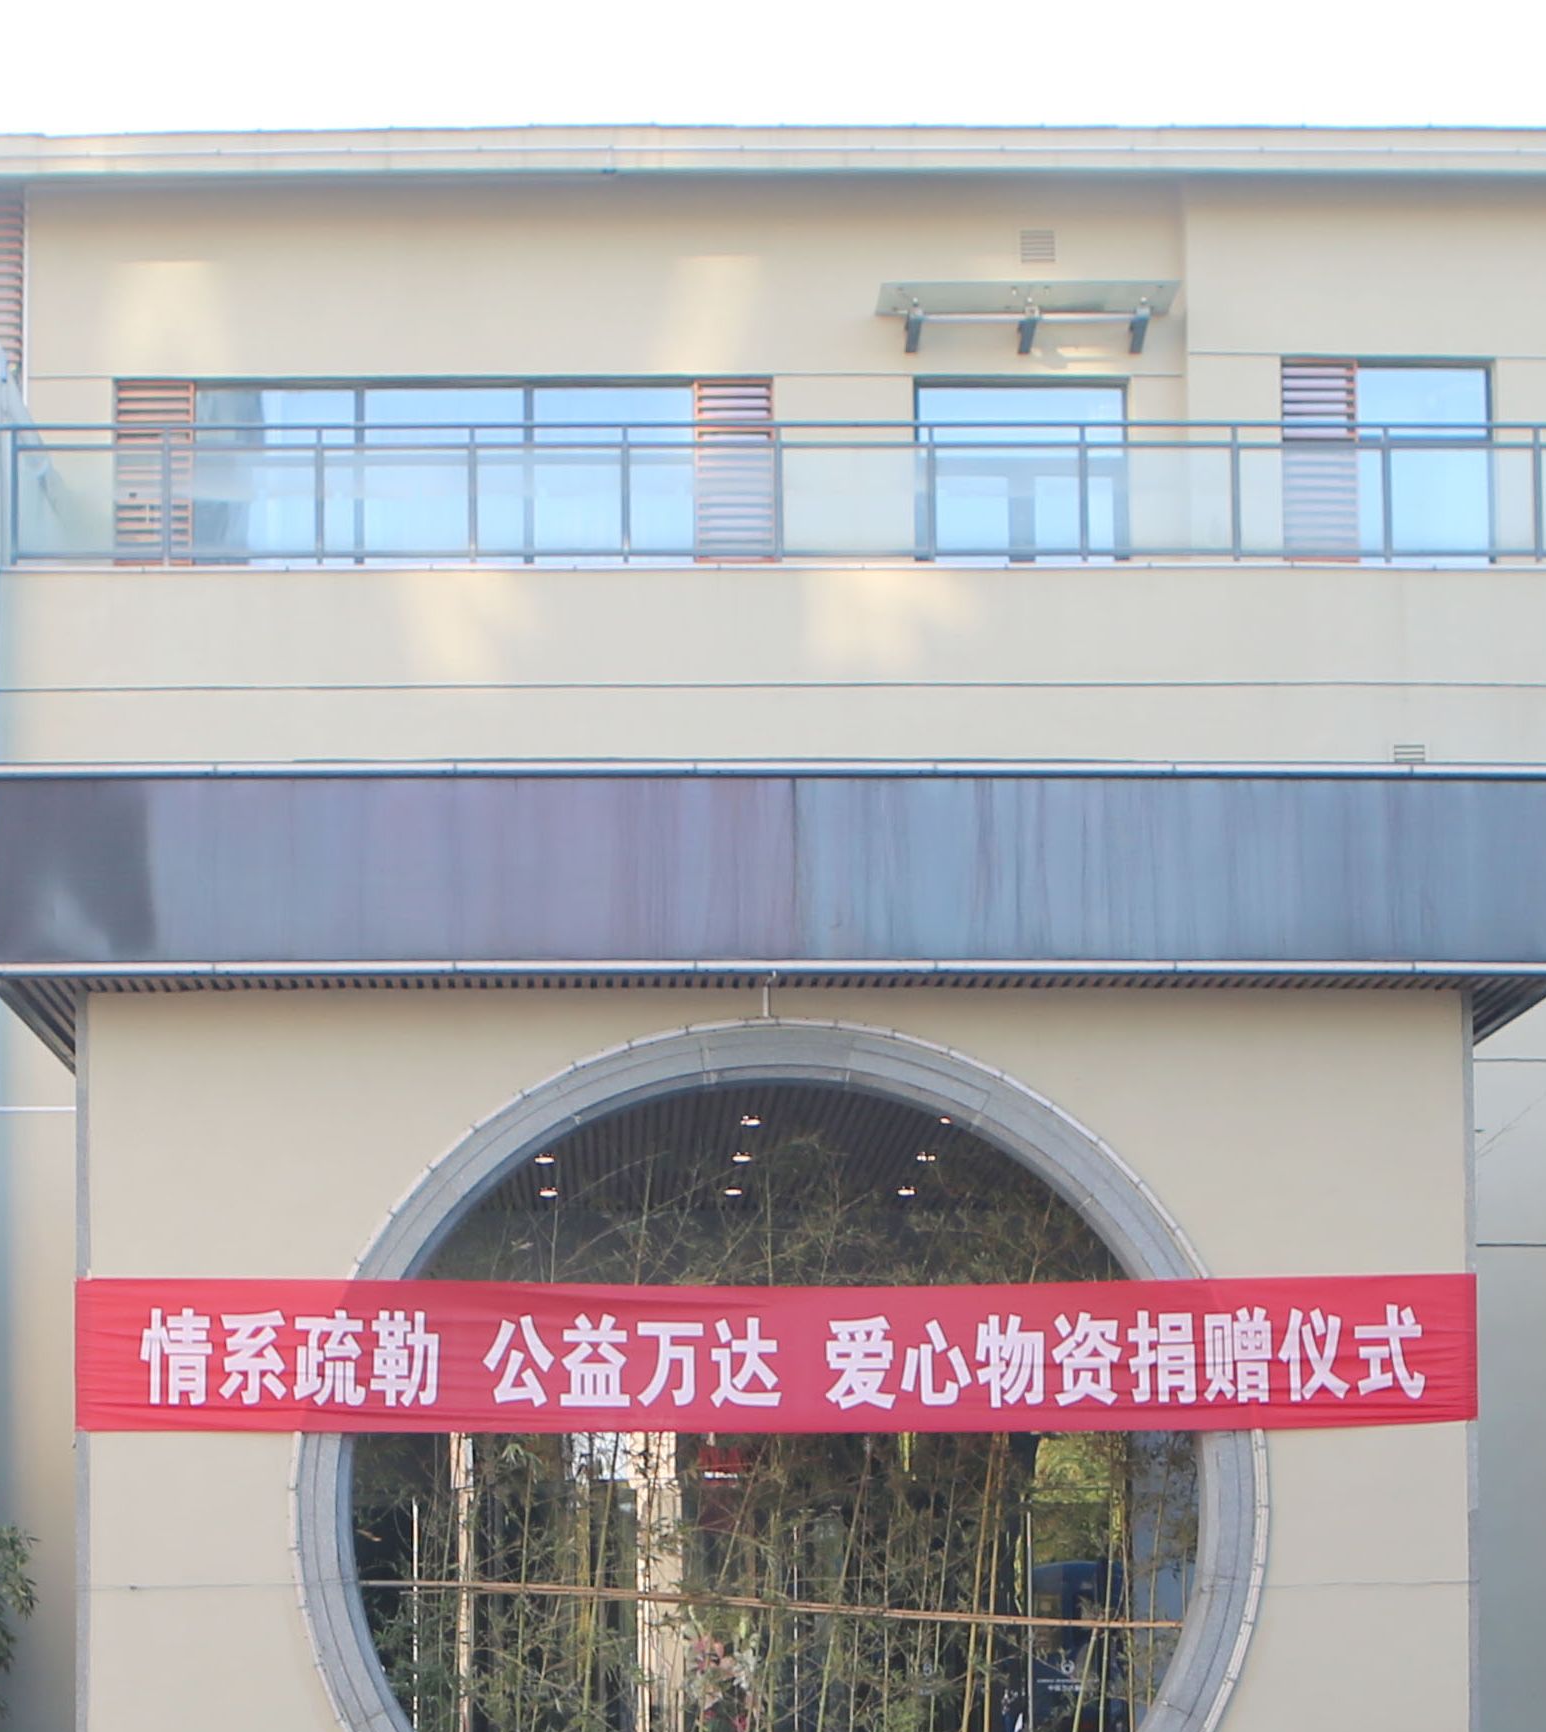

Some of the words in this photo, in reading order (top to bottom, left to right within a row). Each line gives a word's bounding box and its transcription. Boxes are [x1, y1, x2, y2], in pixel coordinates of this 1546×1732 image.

[140, 1308, 440, 1407] 情系疏勒
[483, 1314, 782, 1407] 公益万达
[825, 1304, 1426, 1409] 爱心物资捐赠仪式
